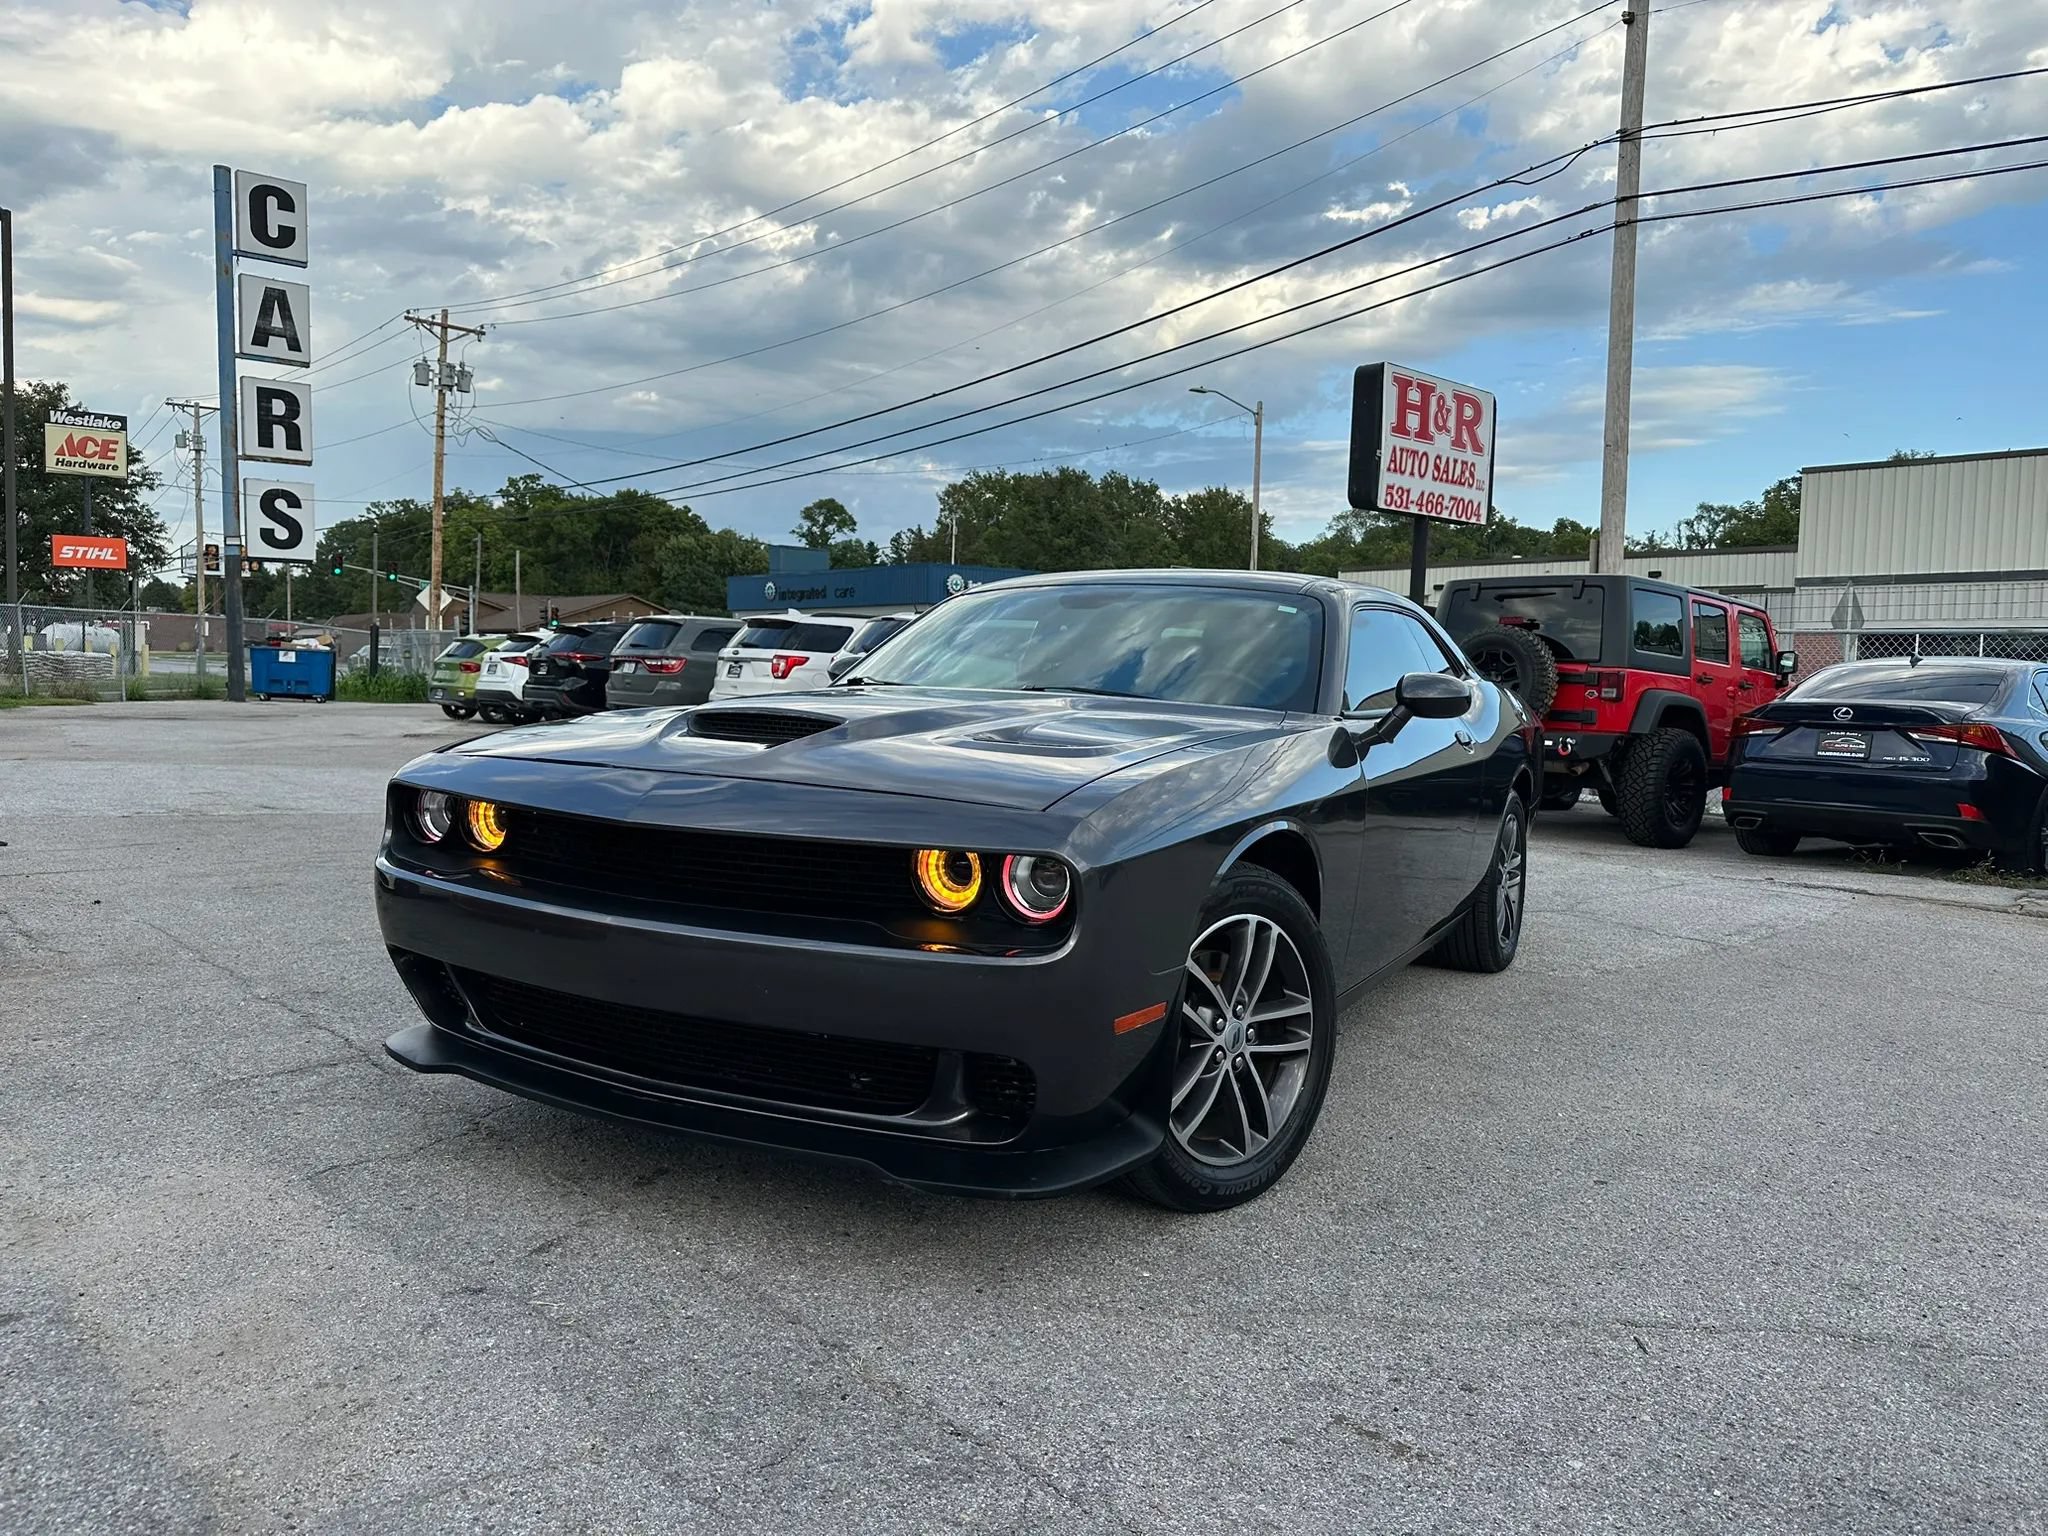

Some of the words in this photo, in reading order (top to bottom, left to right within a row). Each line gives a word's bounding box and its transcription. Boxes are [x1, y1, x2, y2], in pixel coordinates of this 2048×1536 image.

[249, 184, 303, 550] CARS
[50, 410, 122, 430] Westlake
[1391, 373, 1485, 455] H&R
[54, 432, 119, 460] ACE
[55, 458, 119, 471] Hardware
[1387, 446, 1429, 478] AUTO
[1432, 455, 1476, 487] SALES
[1476, 478, 1486, 492] LLC
[1384, 484, 1481, 521] 531-466-7004
[59, 546, 118, 561] STIHL
[778, 585, 826, 601] integrated
[834, 586, 856, 599] care
